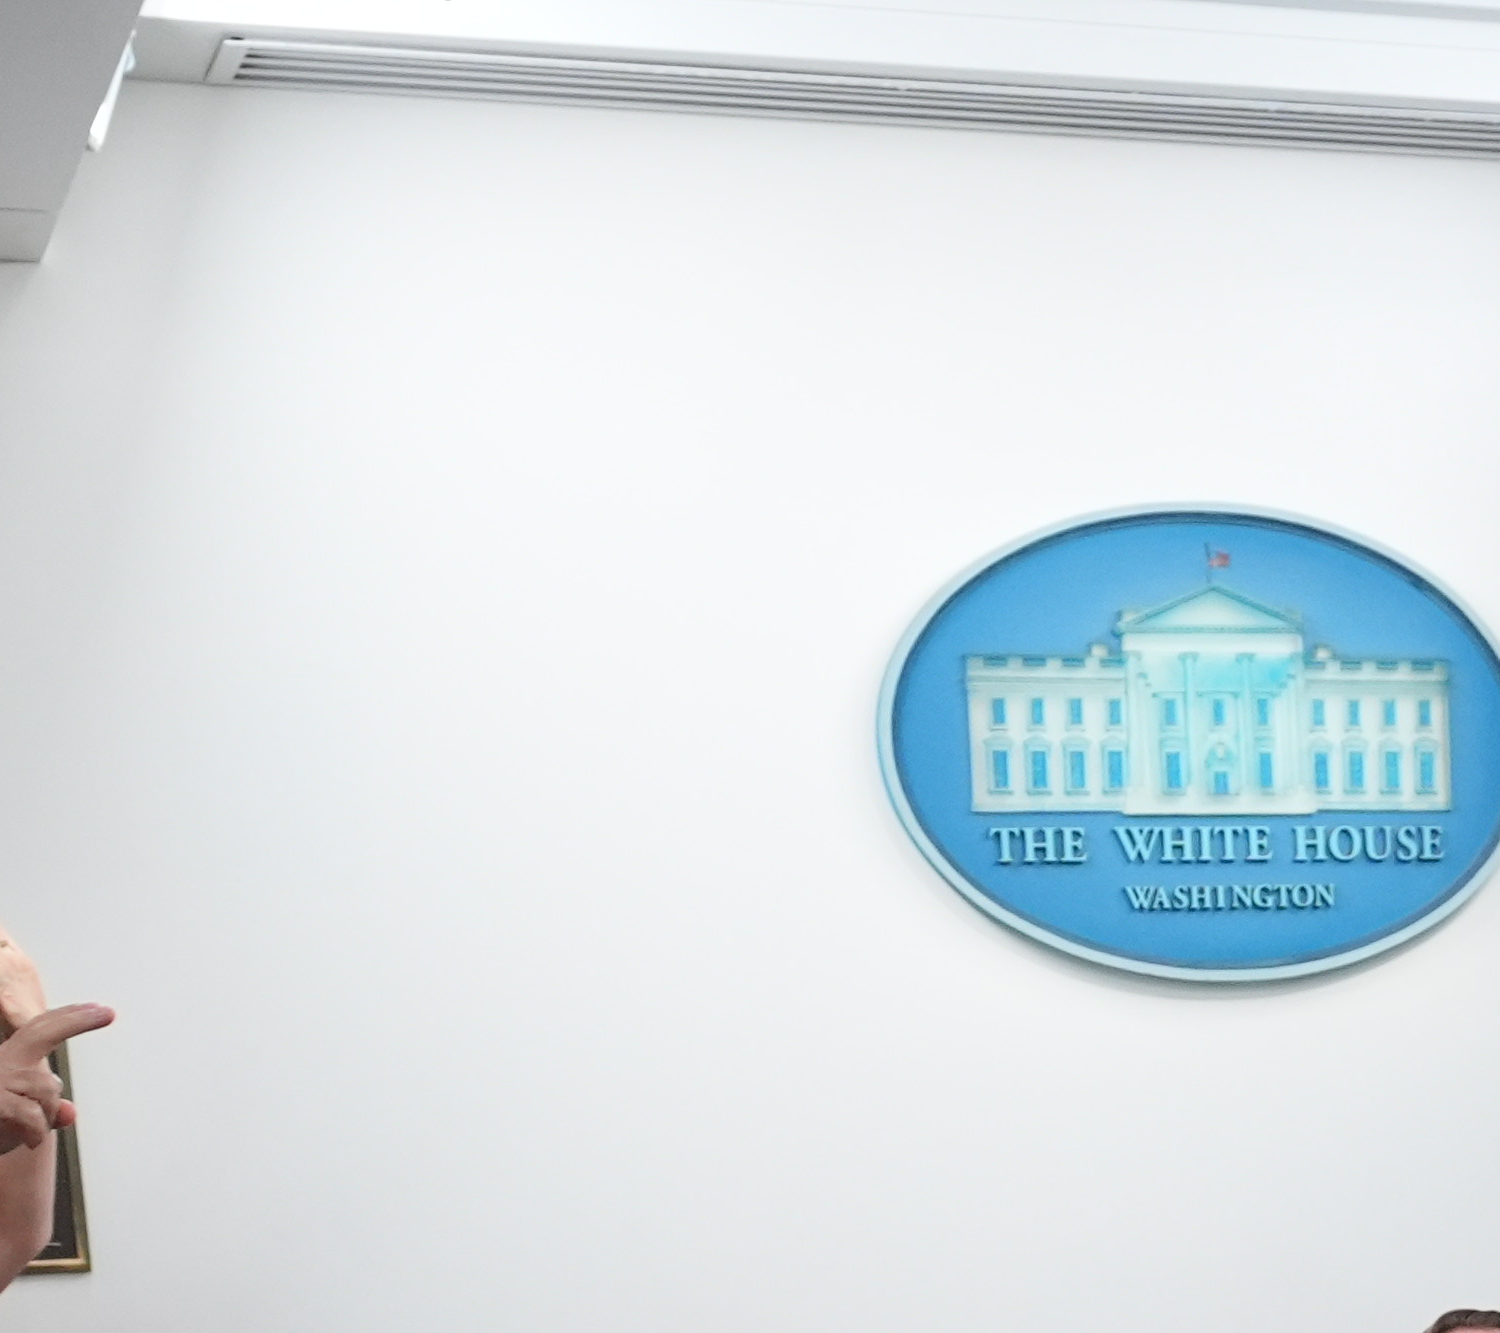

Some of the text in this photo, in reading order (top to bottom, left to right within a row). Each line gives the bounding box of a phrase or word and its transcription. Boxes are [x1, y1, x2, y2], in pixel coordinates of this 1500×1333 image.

[989, 825, 1446, 863] THE WHITE HOUSE
[1124, 884, 1337, 911] WASHINGTON
